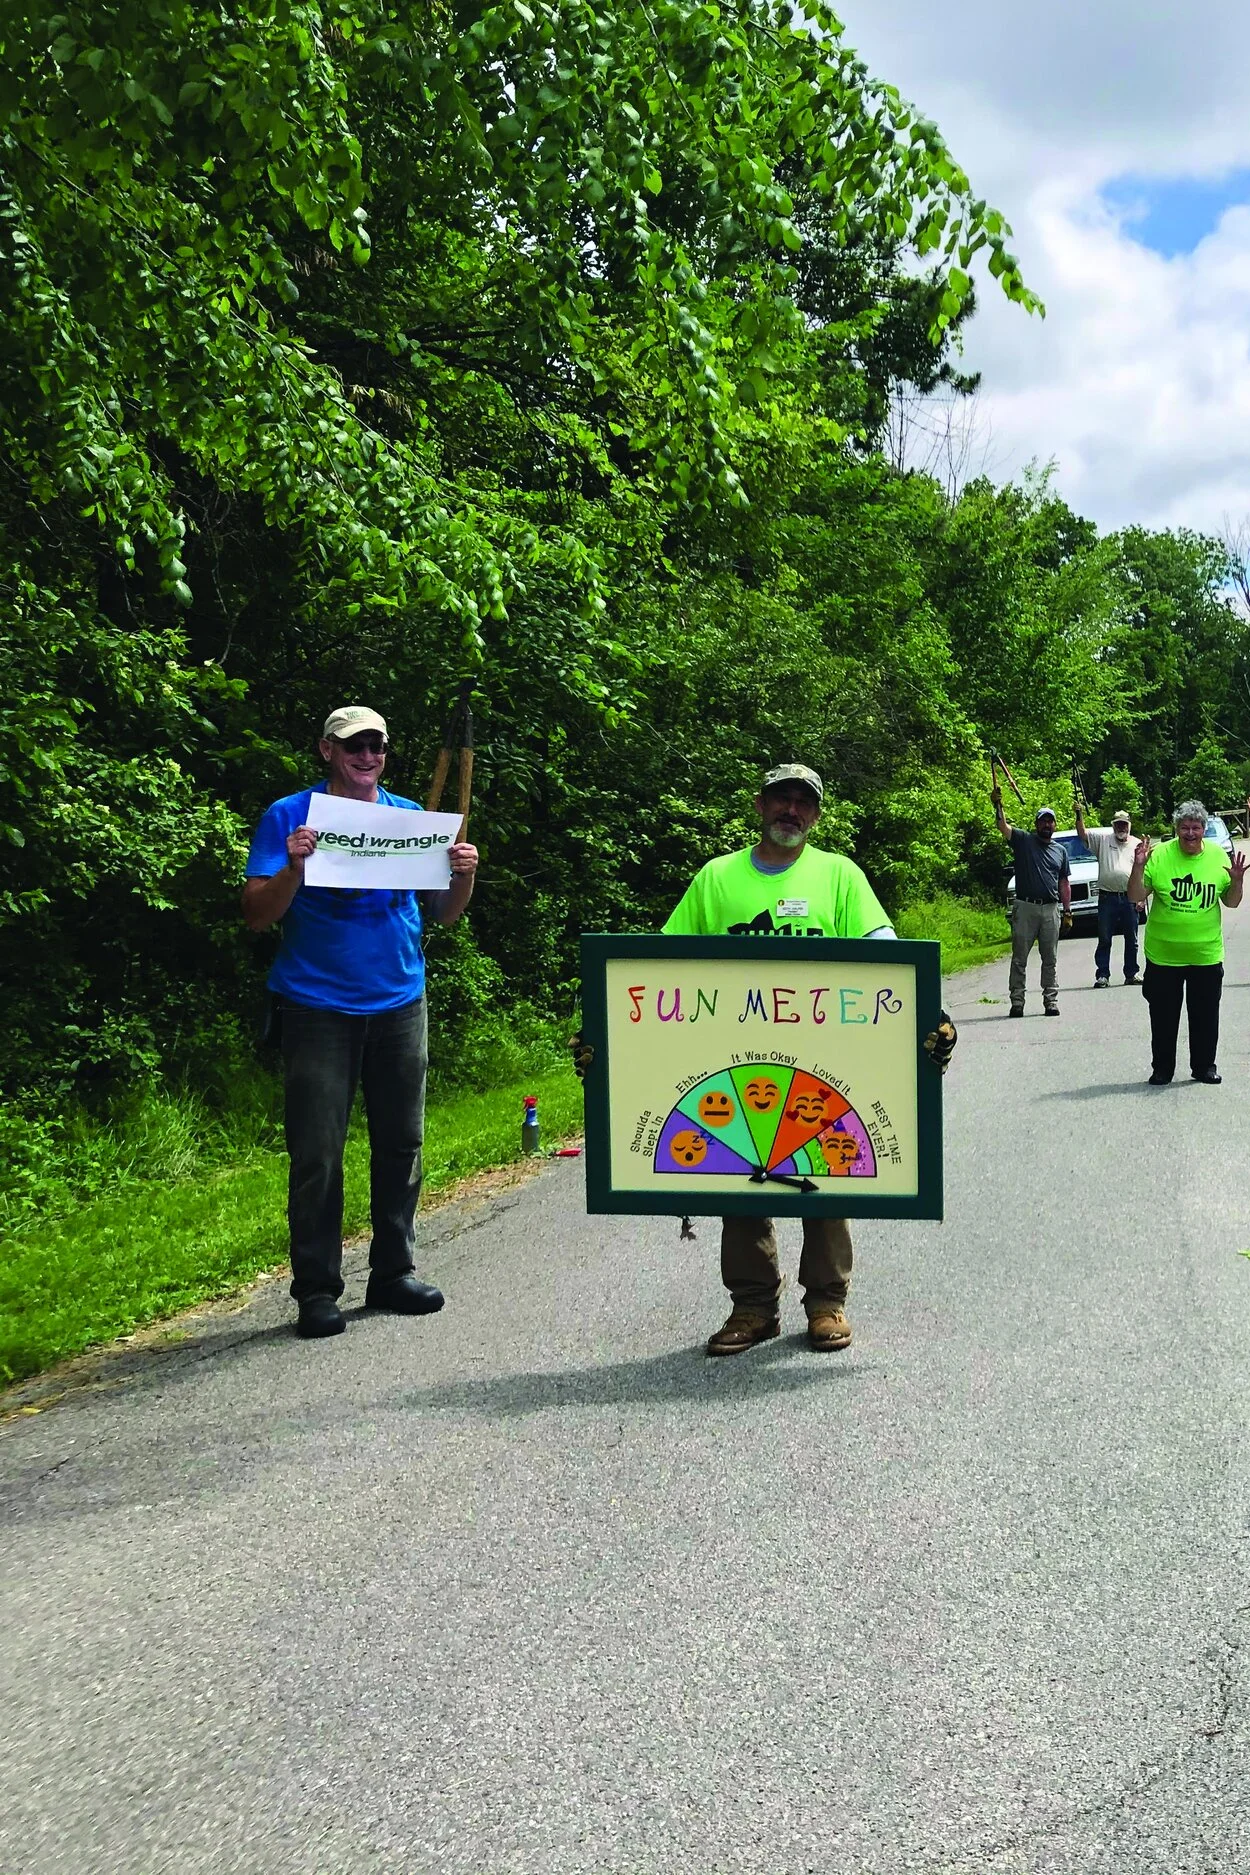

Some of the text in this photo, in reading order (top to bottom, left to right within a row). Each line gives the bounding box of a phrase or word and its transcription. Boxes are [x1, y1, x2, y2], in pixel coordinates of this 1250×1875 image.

[350, 849, 387, 858] Indiana
[370, 834, 450, 849] wrangle
[628, 985, 903, 1025] FUN METER
[730, 1051, 798, 1065] It Was Okay
[812, 1063, 852, 1096] Loved It
[630, 1109, 652, 1153] Shoulda
[642, 1115, 664, 1158] Slept In
[867, 1121, 890, 1159] EVER!
[871, 1100, 902, 1165] BEST TIME
